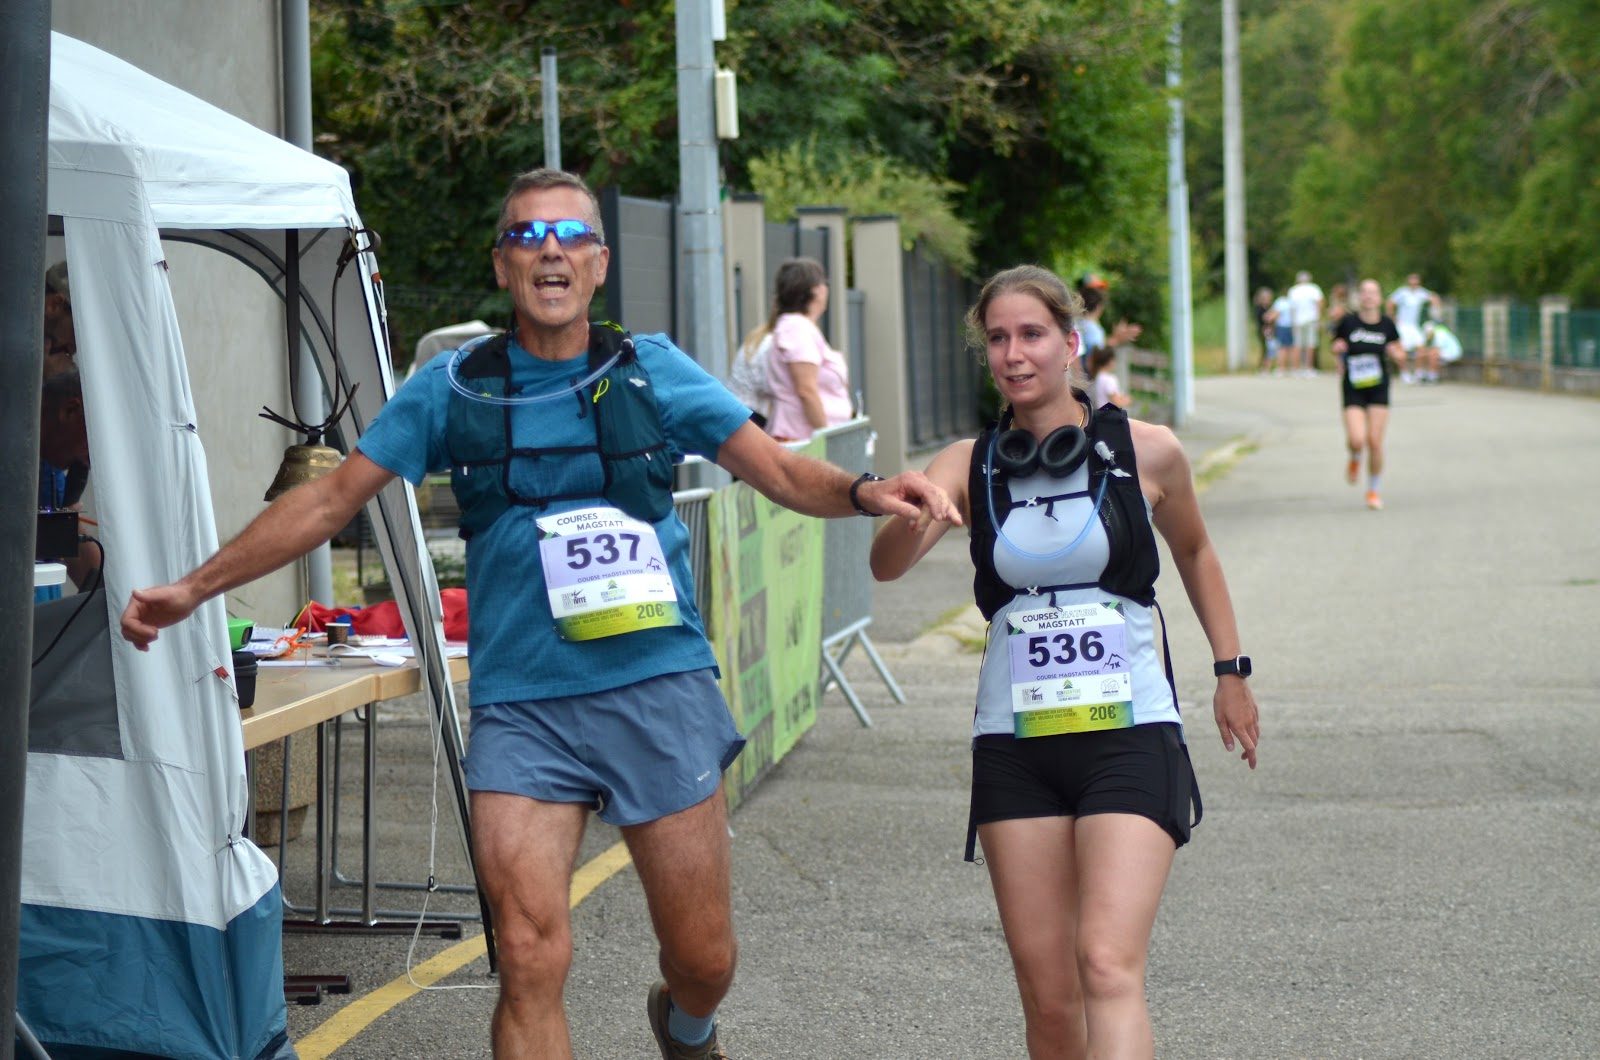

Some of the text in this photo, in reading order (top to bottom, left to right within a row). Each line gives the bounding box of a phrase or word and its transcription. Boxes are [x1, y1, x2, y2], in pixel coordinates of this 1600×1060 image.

[556, 512, 598, 526] COURSES
[576, 520, 624, 532] MAGSTATT
[566, 533, 641, 570] 537
[1022, 611, 1059, 623] COURSES
[1038, 618, 1086, 630] MAGSTATT
[1028, 630, 1105, 668] 536
[1109, 661, 1121, 670] 7K
[1036, 669, 1100, 681] COURSE MAGSTATTOISE
